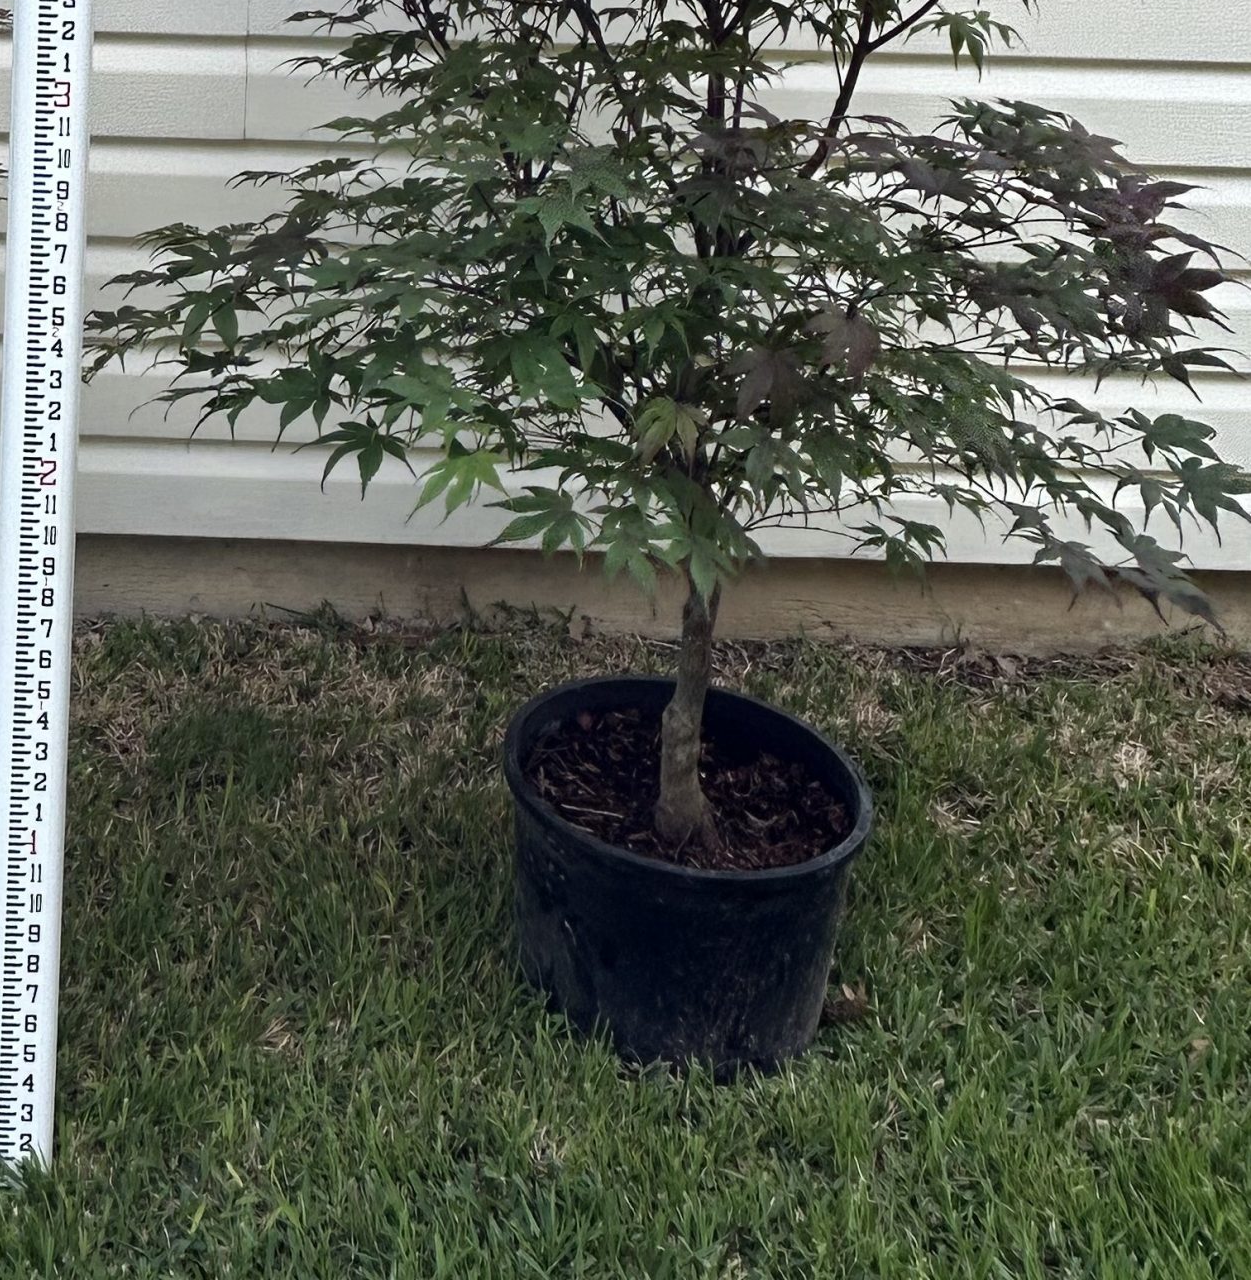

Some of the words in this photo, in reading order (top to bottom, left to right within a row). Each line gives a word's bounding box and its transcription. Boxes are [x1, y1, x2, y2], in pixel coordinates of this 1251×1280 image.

[61, 21, 75, 41] 2
[63, 52, 71, 73] 1
[54, 82, 71, 107] 3
[59, 116, 71, 137] 11
[57, 148, 71, 169] 10
[56, 180, 70, 200] 9
[55, 212, 68, 232] 8
[54, 244, 68, 264] 7
[52, 275, 67, 295] 6
[52, 307, 65, 327] 5
[50, 338, 64, 358] 4
[49, 370, 63, 389] 3
[48, 401, 61, 421] 2
[49, 432, 57, 452] 1
[39, 460, 57, 486] 2
[45, 494, 57, 515] 11
[43, 525, 57, 546] 10
[42, 557, 55, 576] 9
[41, 588, 54, 607] 8
[40, 619, 53, 638] 7
[39, 650, 52, 669] 6
[37, 680, 51, 700] 5
[36, 711, 49, 730] 4
[35, 742, 48, 761] 3
[34, 772, 47, 792] 2
[35, 802, 43, 822] 1
[30, 830, 37, 855] 1
[30, 863, 42, 883] 11
[29, 894, 42, 913] 10
[28, 924, 41, 944] 9
[27, 954, 40, 973] 8
[26, 984, 39, 1003] 7
[24, 1014, 38, 1033] 6
[23, 1044, 36, 1063] 5
[22, 1074, 34, 1093] 4
[20, 1103, 34, 1122] 3
[19, 1133, 33, 1152] 2
